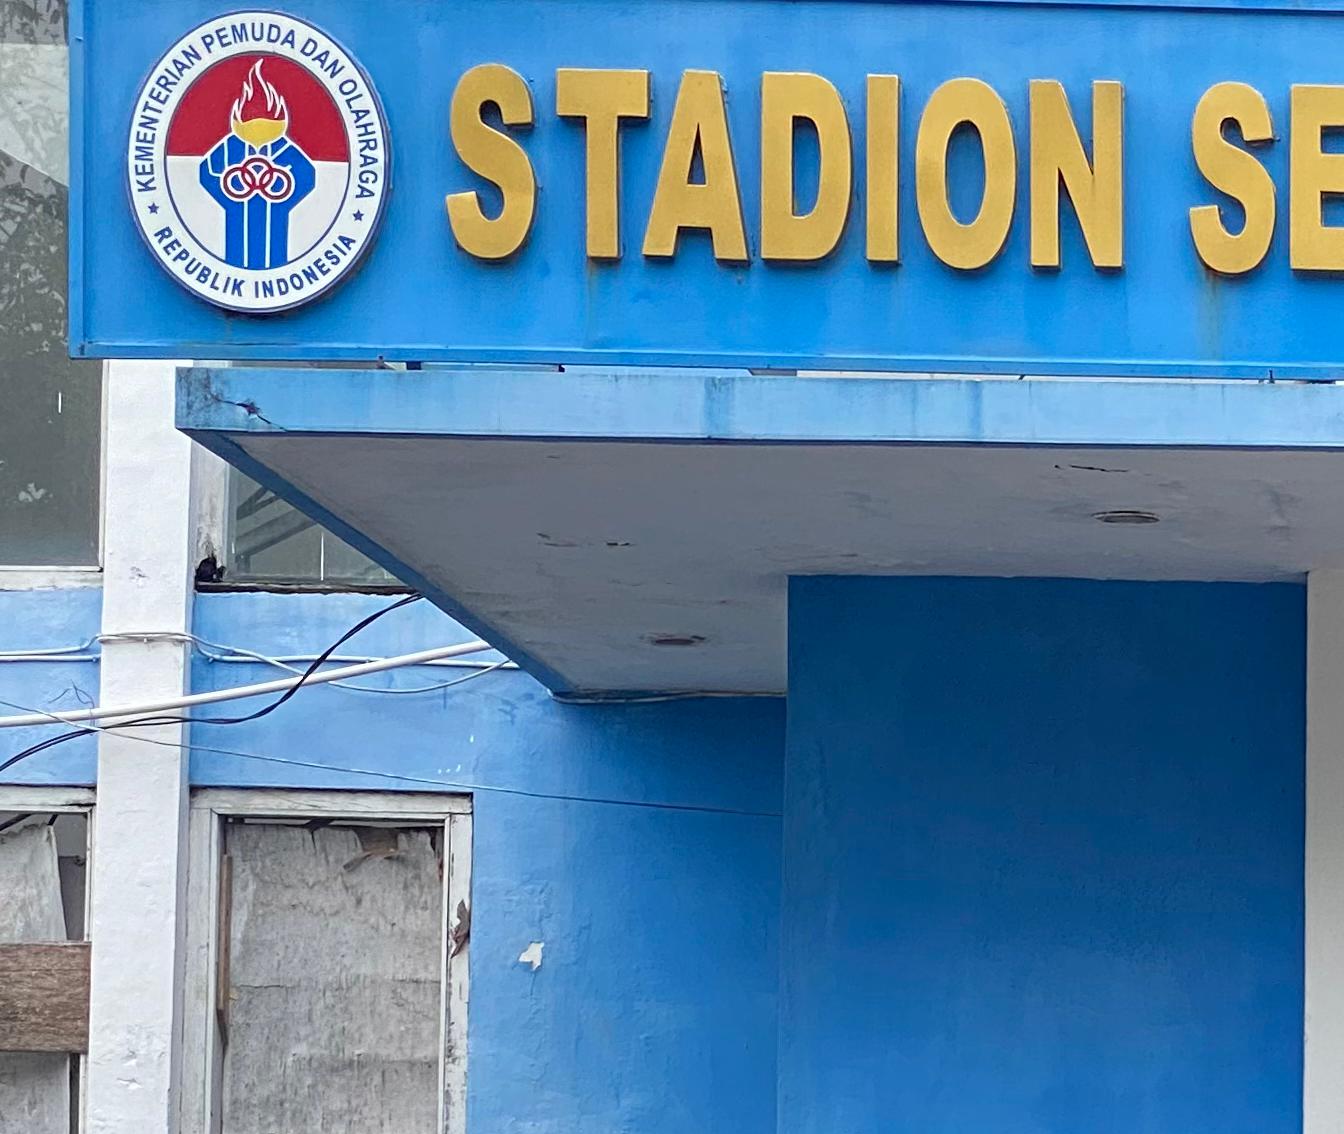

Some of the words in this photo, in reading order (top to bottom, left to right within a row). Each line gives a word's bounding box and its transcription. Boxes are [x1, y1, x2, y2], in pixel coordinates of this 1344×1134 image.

[136, 45, 202, 193] KEMENTERIAN
[202, 22, 296, 54] PEMUDA
[299, 35, 345, 80] DAN
[339, 78, 379, 200] OLAHRAGA
[446, 64, 1123, 269] STADION
[154, 225, 245, 297] REPUBLIK
[254, 235, 357, 298] INDONESIA
